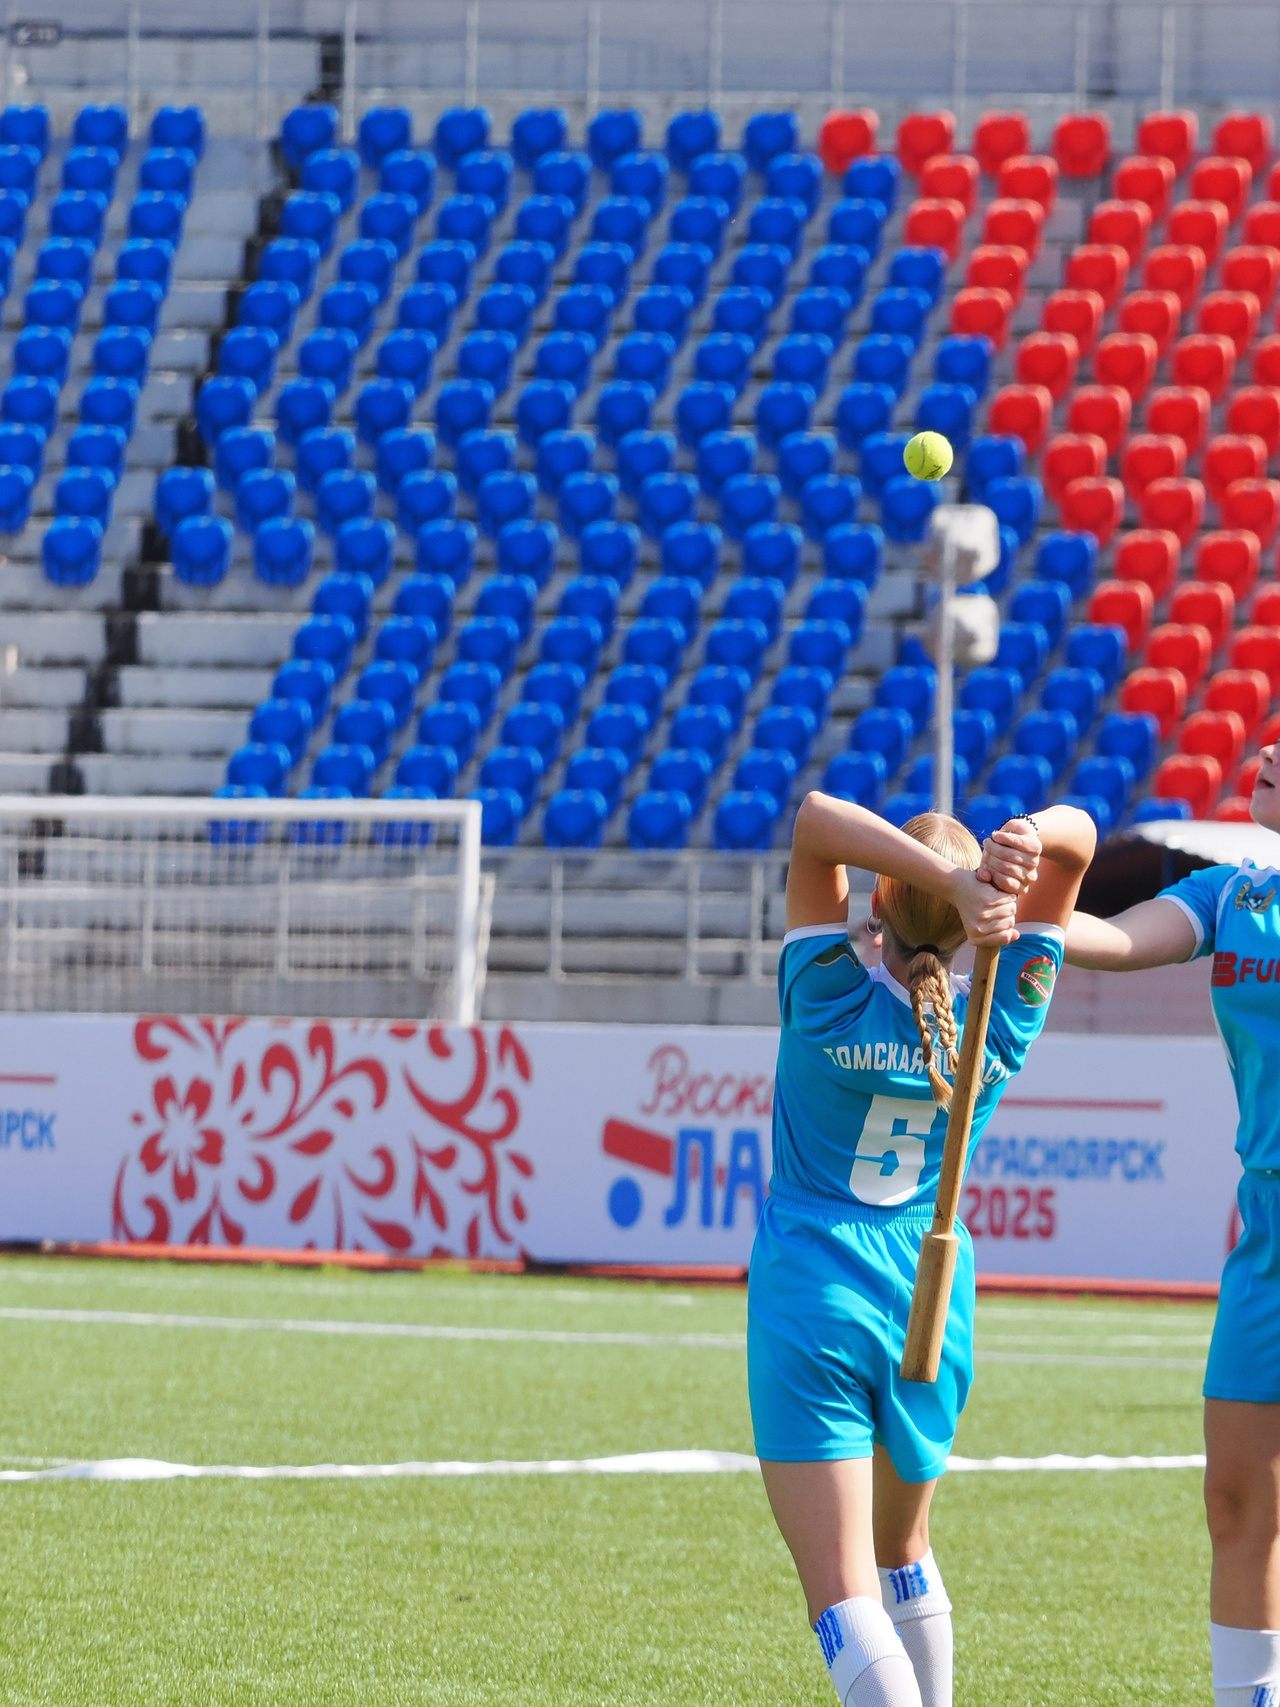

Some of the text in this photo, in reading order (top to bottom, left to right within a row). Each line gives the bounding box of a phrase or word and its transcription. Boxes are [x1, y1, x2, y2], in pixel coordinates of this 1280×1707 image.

[823, 1042, 924, 1075] ТОМСКАЯ
[849, 1094, 938, 1206] 5
[965, 1185, 1056, 1240] 2025
